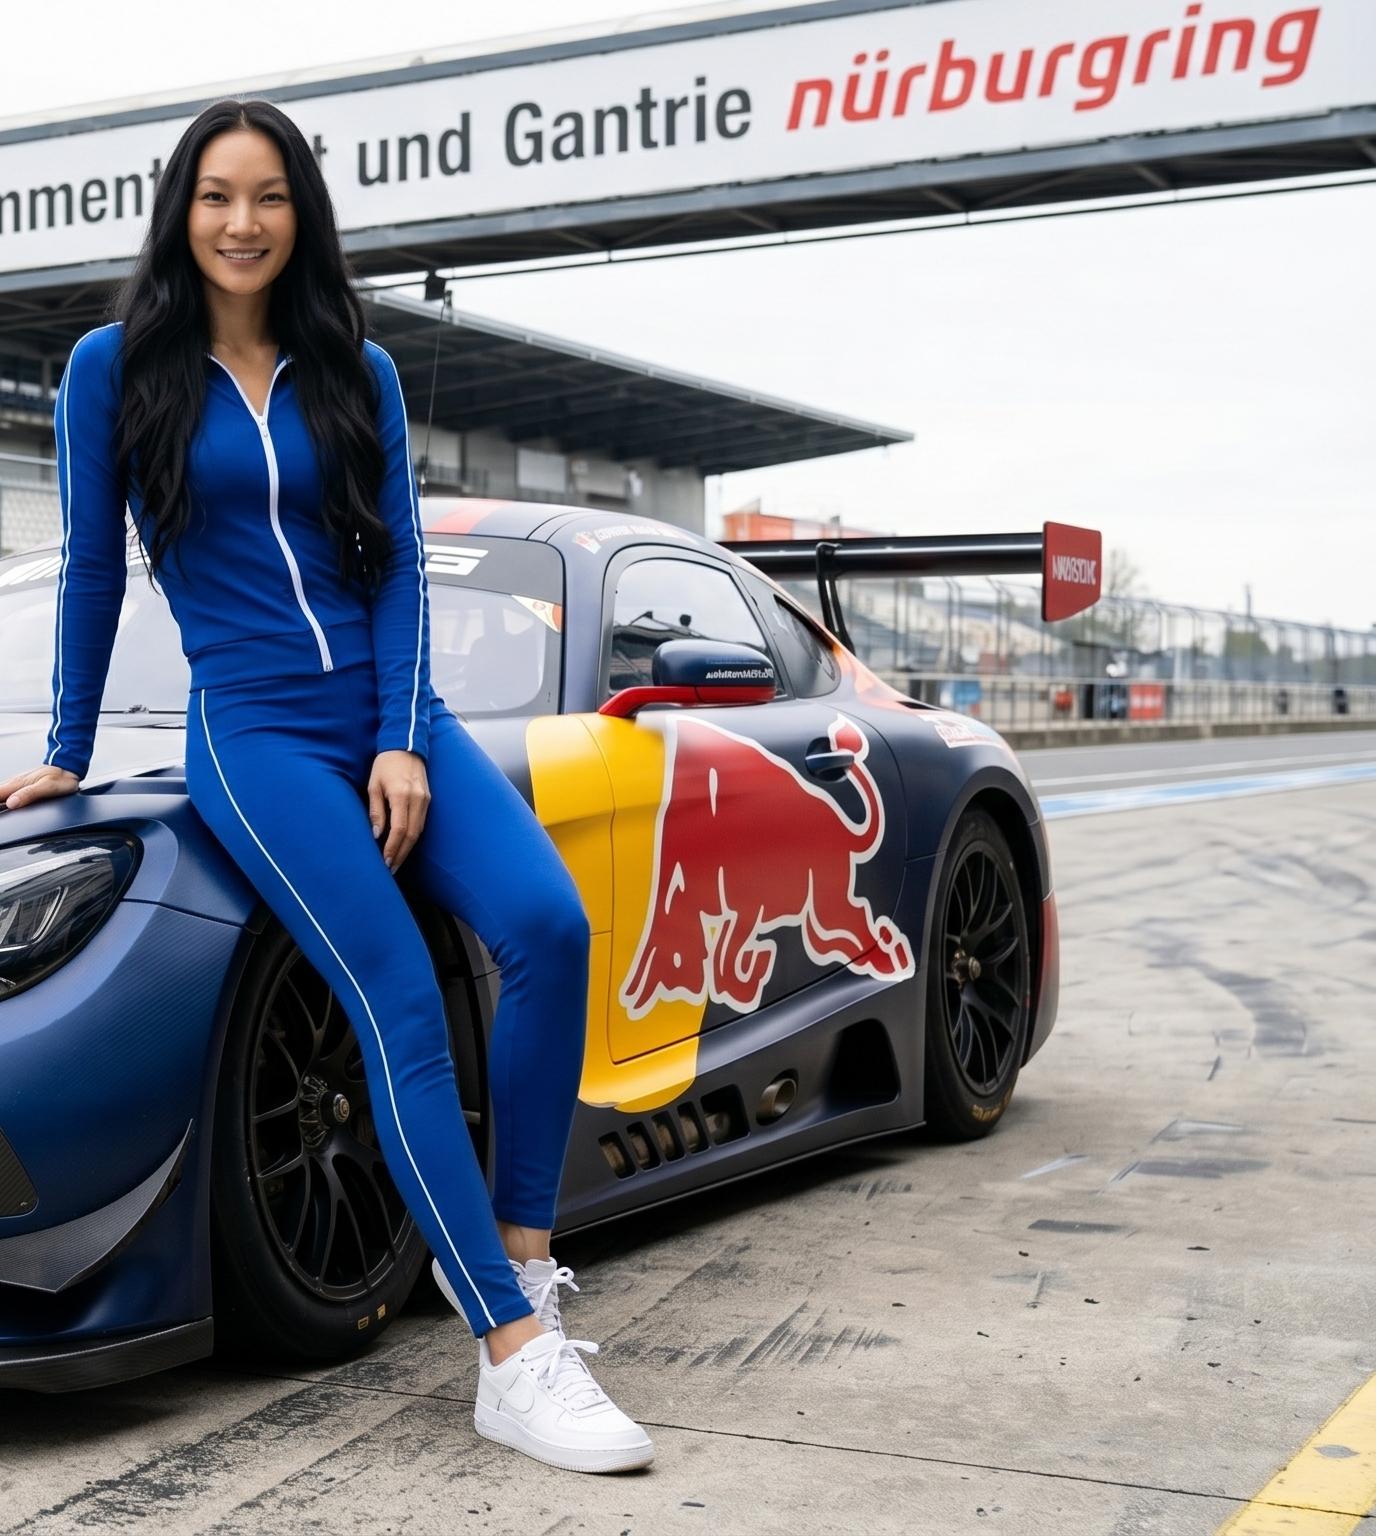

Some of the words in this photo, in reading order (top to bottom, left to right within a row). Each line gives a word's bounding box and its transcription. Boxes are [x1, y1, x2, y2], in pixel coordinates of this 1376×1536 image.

[358, 112, 471, 187] und
[505, 76, 752, 167] Gantrie
[787, 3, 1320, 131] nürburgring
